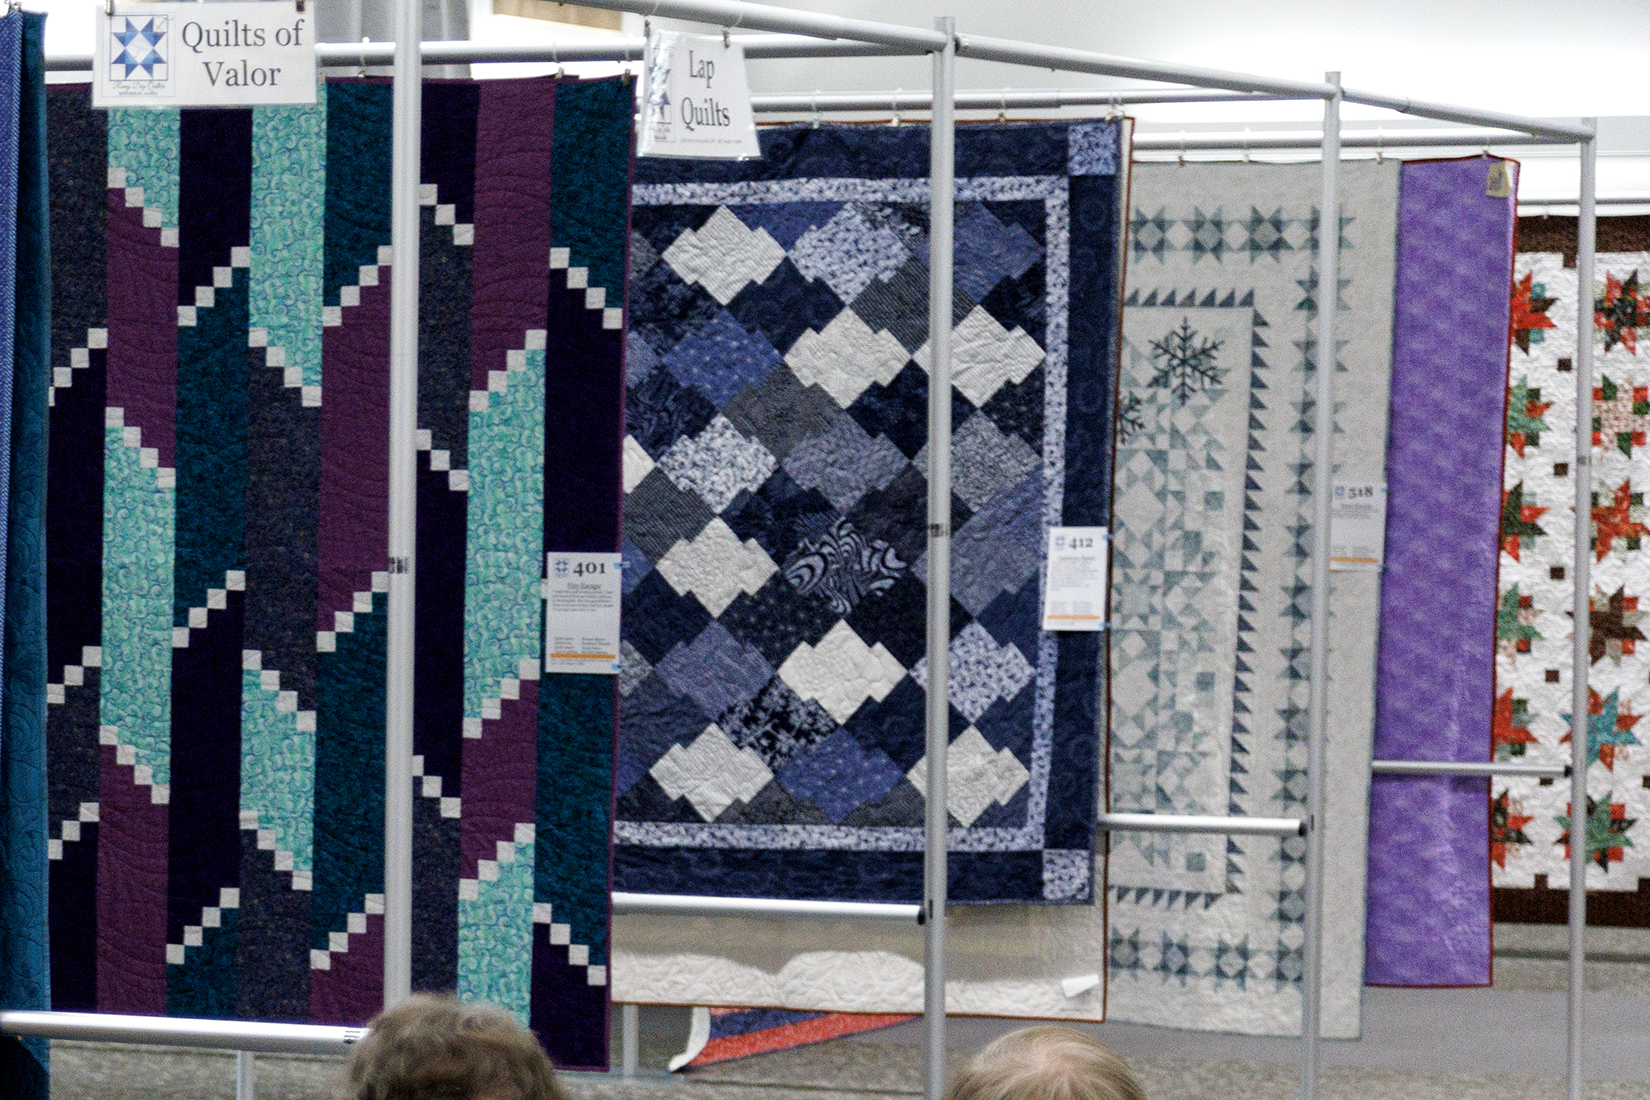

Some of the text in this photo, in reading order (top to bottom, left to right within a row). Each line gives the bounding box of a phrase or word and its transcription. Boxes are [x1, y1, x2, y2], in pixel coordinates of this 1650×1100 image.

[182, 18, 306, 54] Quilts of
[202, 59, 282, 87] Valor
[688, 49, 716, 89] Lap
[680, 96, 731, 132] Quilts
[1068, 537, 1093, 550] 412
[572, 561, 606, 577] 401
